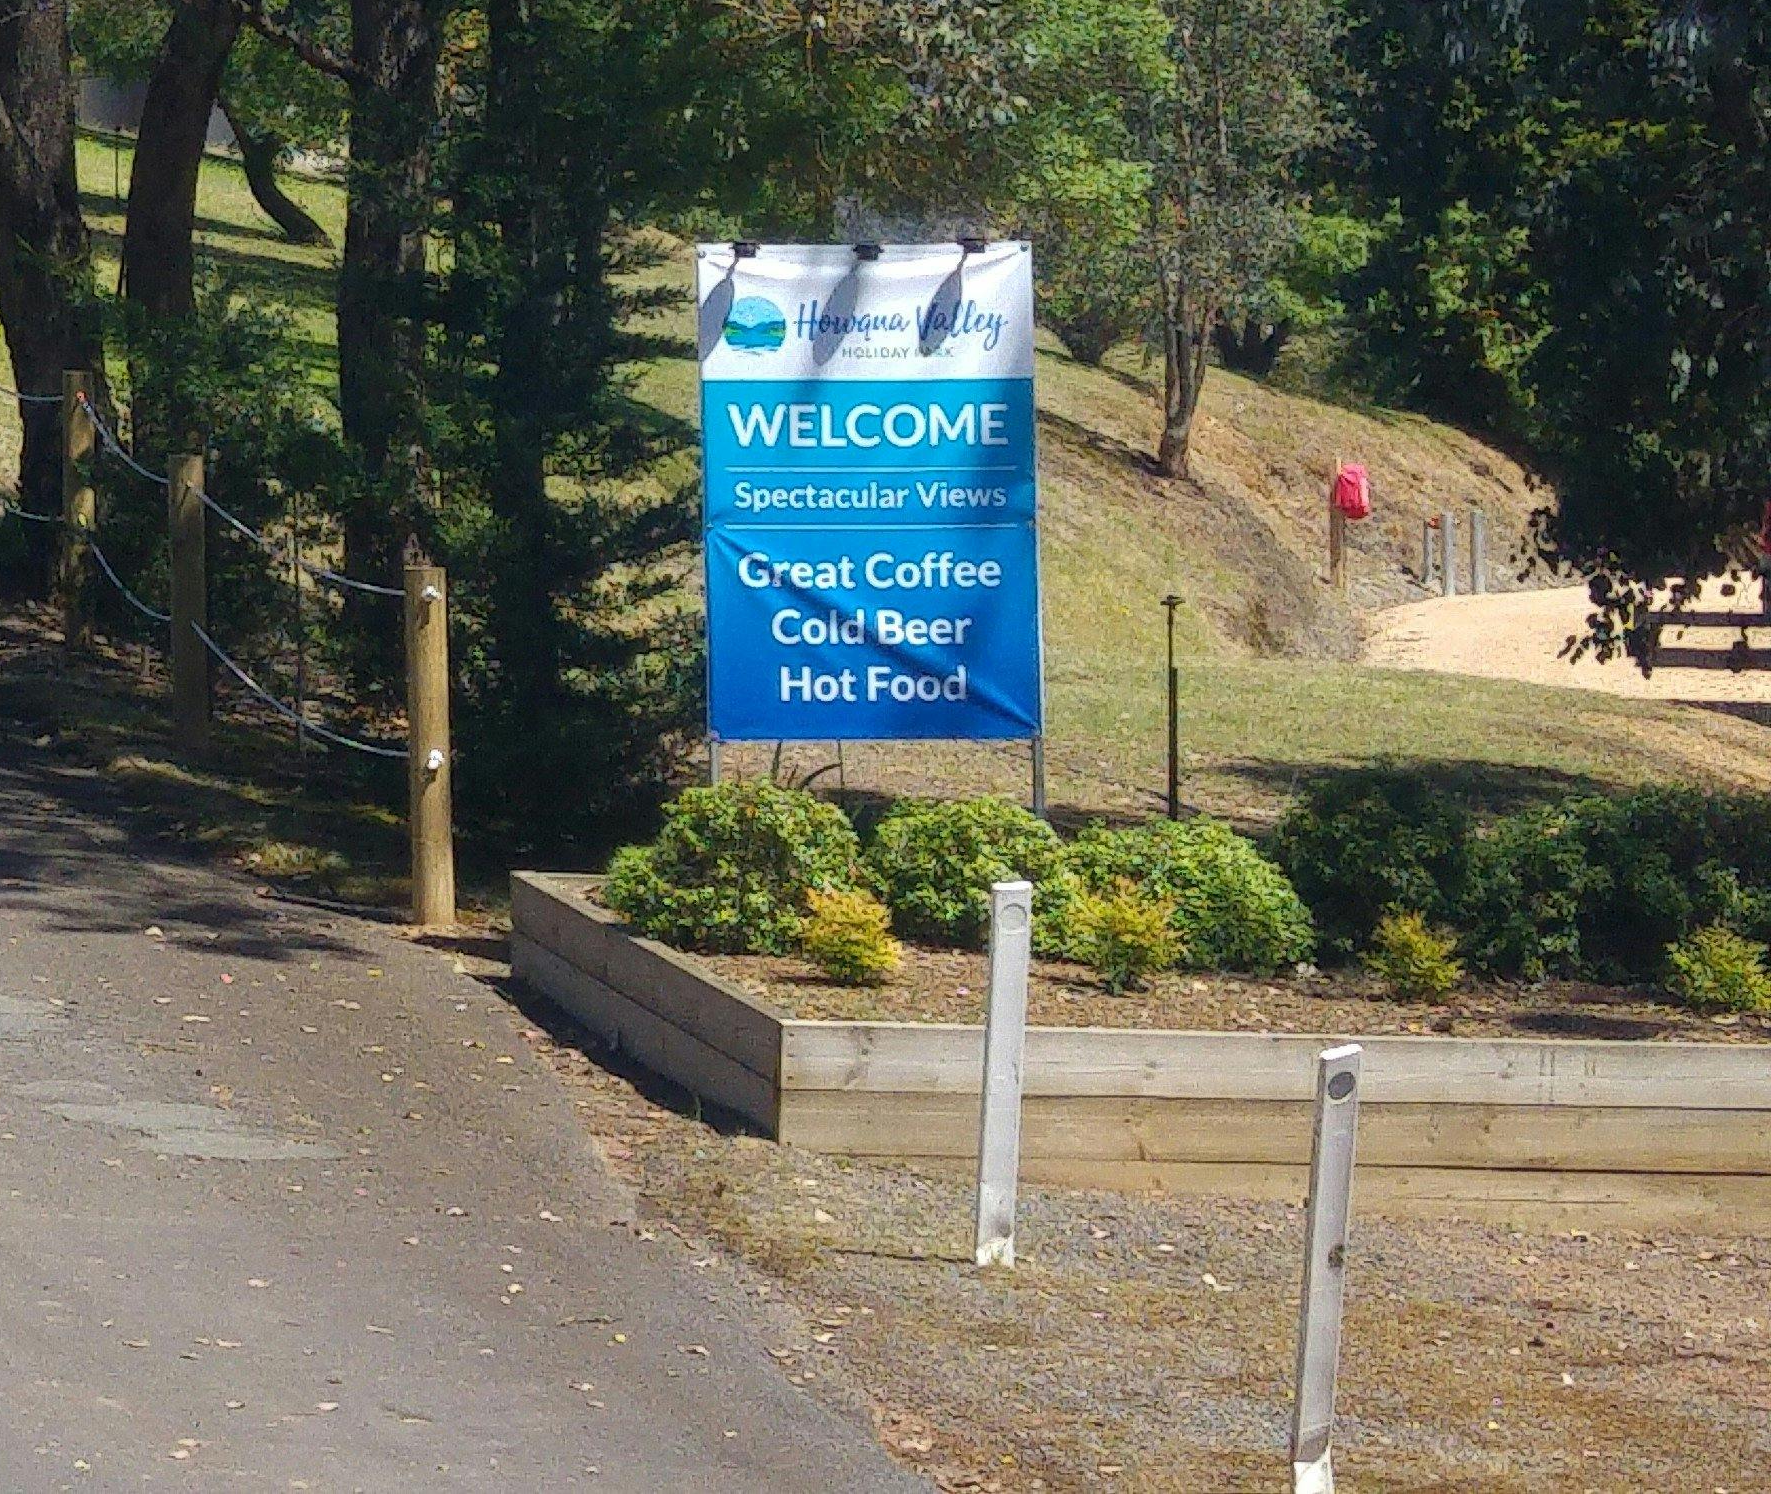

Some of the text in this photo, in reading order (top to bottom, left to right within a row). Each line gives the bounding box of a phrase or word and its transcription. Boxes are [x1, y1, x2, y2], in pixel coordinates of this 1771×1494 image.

[793, 299, 1009, 352] Howqua Valley
[842, 346, 910, 358] HOLIDAY
[727, 403, 1008, 448] WELCOME
[734, 481, 1007, 513] Spectacular Views
[737, 552, 1001, 589] Great Coffee
[771, 609, 972, 646] Cold Beer
[779, 665, 968, 703] Hot Food
